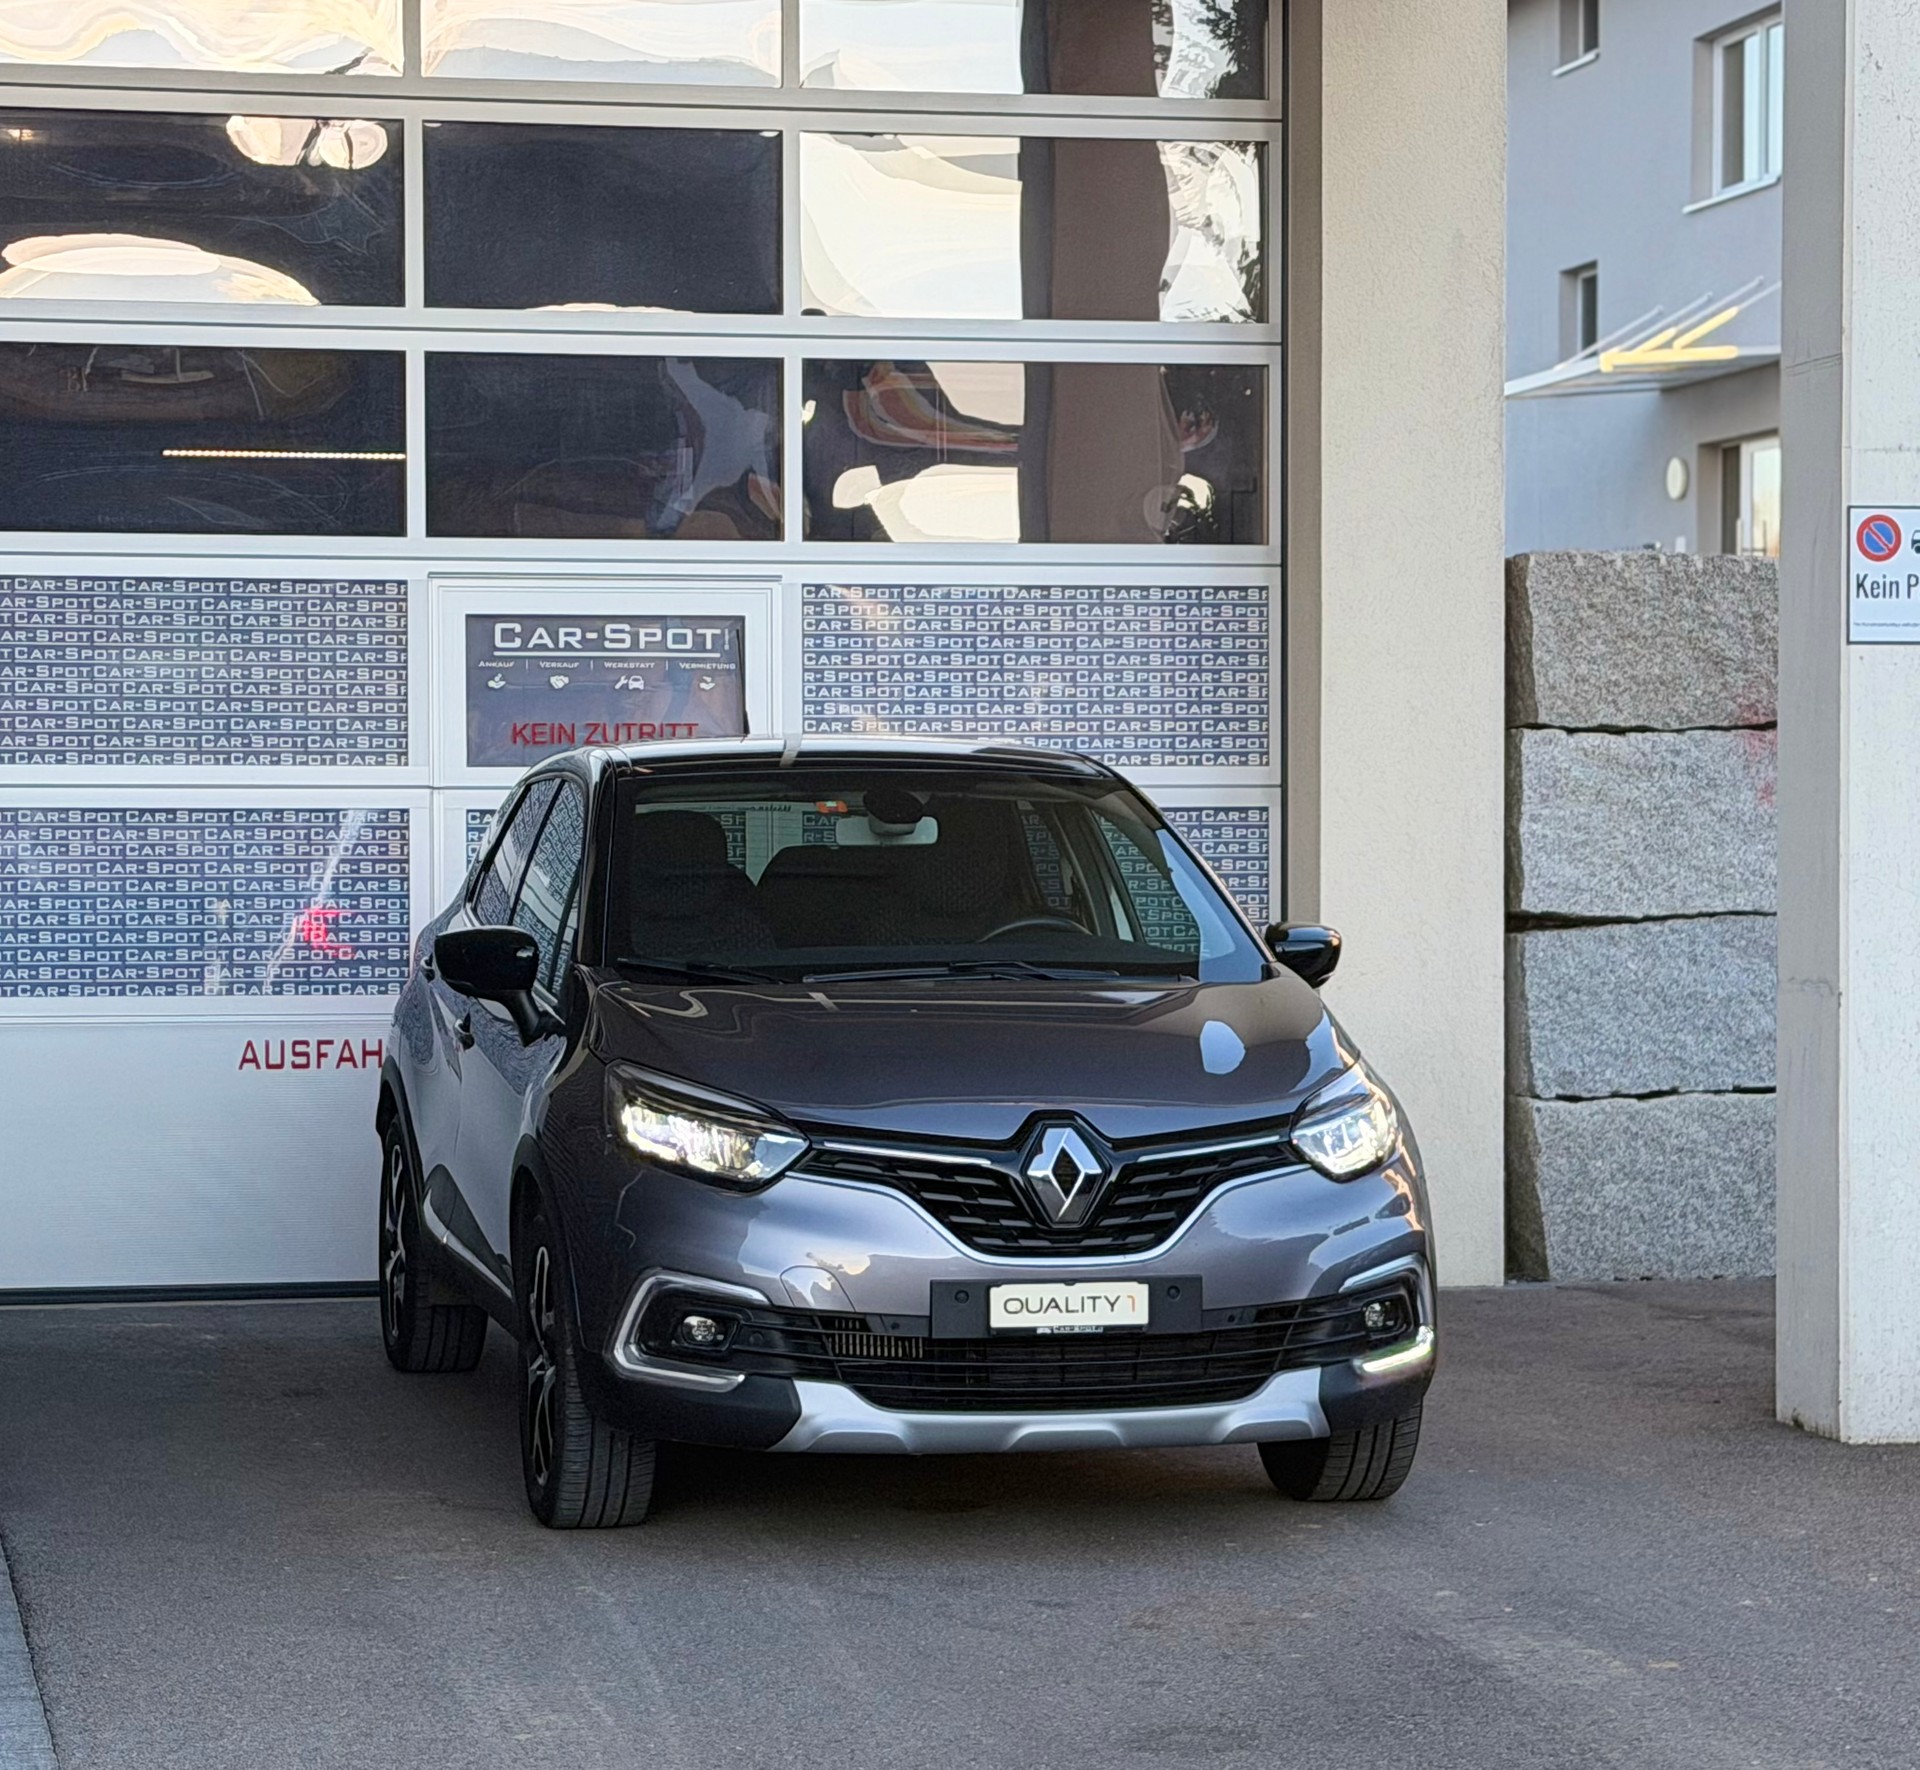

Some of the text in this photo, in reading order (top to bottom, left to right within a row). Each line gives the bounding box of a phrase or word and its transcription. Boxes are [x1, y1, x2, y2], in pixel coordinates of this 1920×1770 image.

[1855, 573, 1900, 599] Kein
[803, 586, 901, 599] CARSPOT
[904, 586, 1002, 599] CARSPOT
[493, 622, 722, 650] CAR-SPOT
[511, 722, 699, 746] KEIN ZUTRITT
[0, 828, 94, 840] AR-SPOT
[310, 828, 408, 840] CARSPOT
[0, 862, 94, 874] AR-SPOT
[0, 898, 94, 910] AR-SPOT
[0, 931, 94, 943] AR-SPOT
[232, 948, 338, 960] CARSPOT
[0, 967, 94, 979] AR-SPOT
[238, 1039, 383, 1070] AUSFAH
[1003, 1295, 1121, 1315] QUALITY
